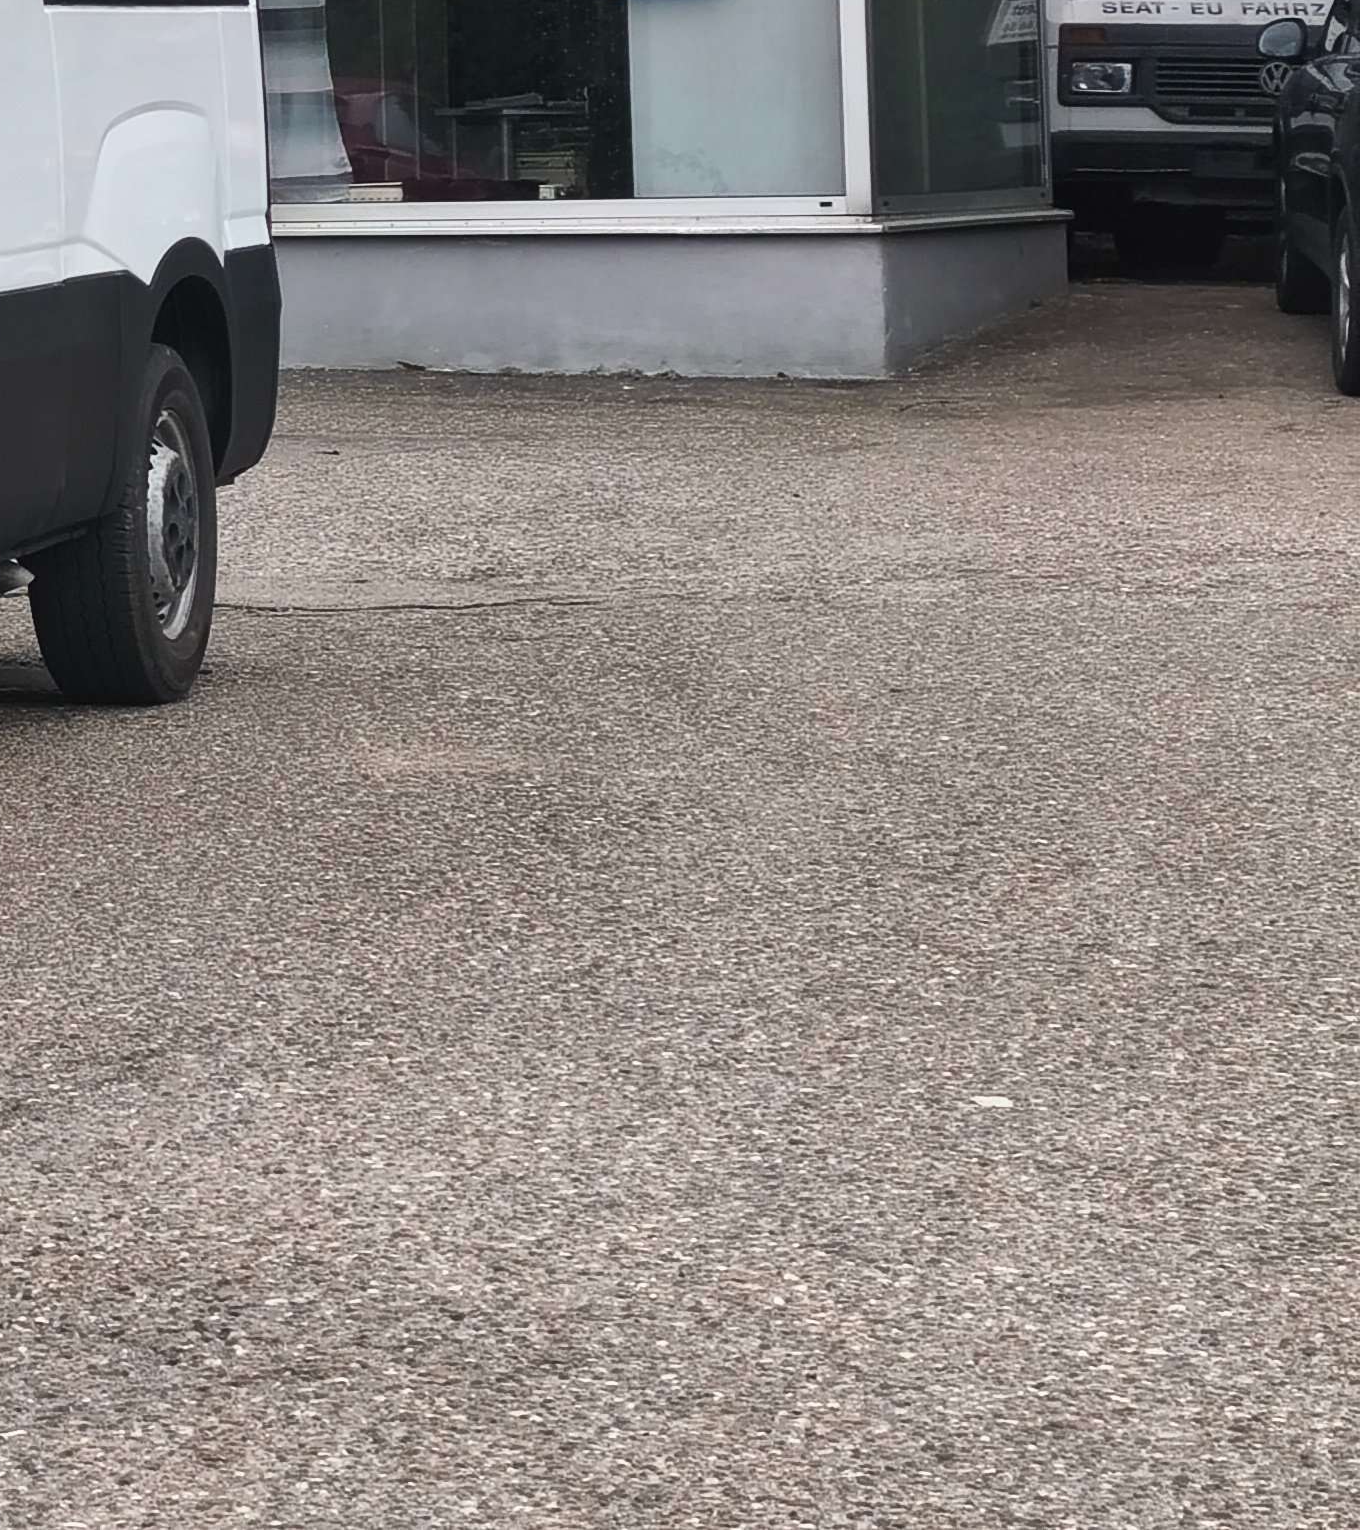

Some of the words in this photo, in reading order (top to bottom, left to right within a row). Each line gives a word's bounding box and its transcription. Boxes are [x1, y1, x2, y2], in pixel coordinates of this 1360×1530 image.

[1102, 1, 1165, 15] SEAT
[1191, 4, 1223, 16] EU
[1241, 2, 1327, 18] FAHRZ
